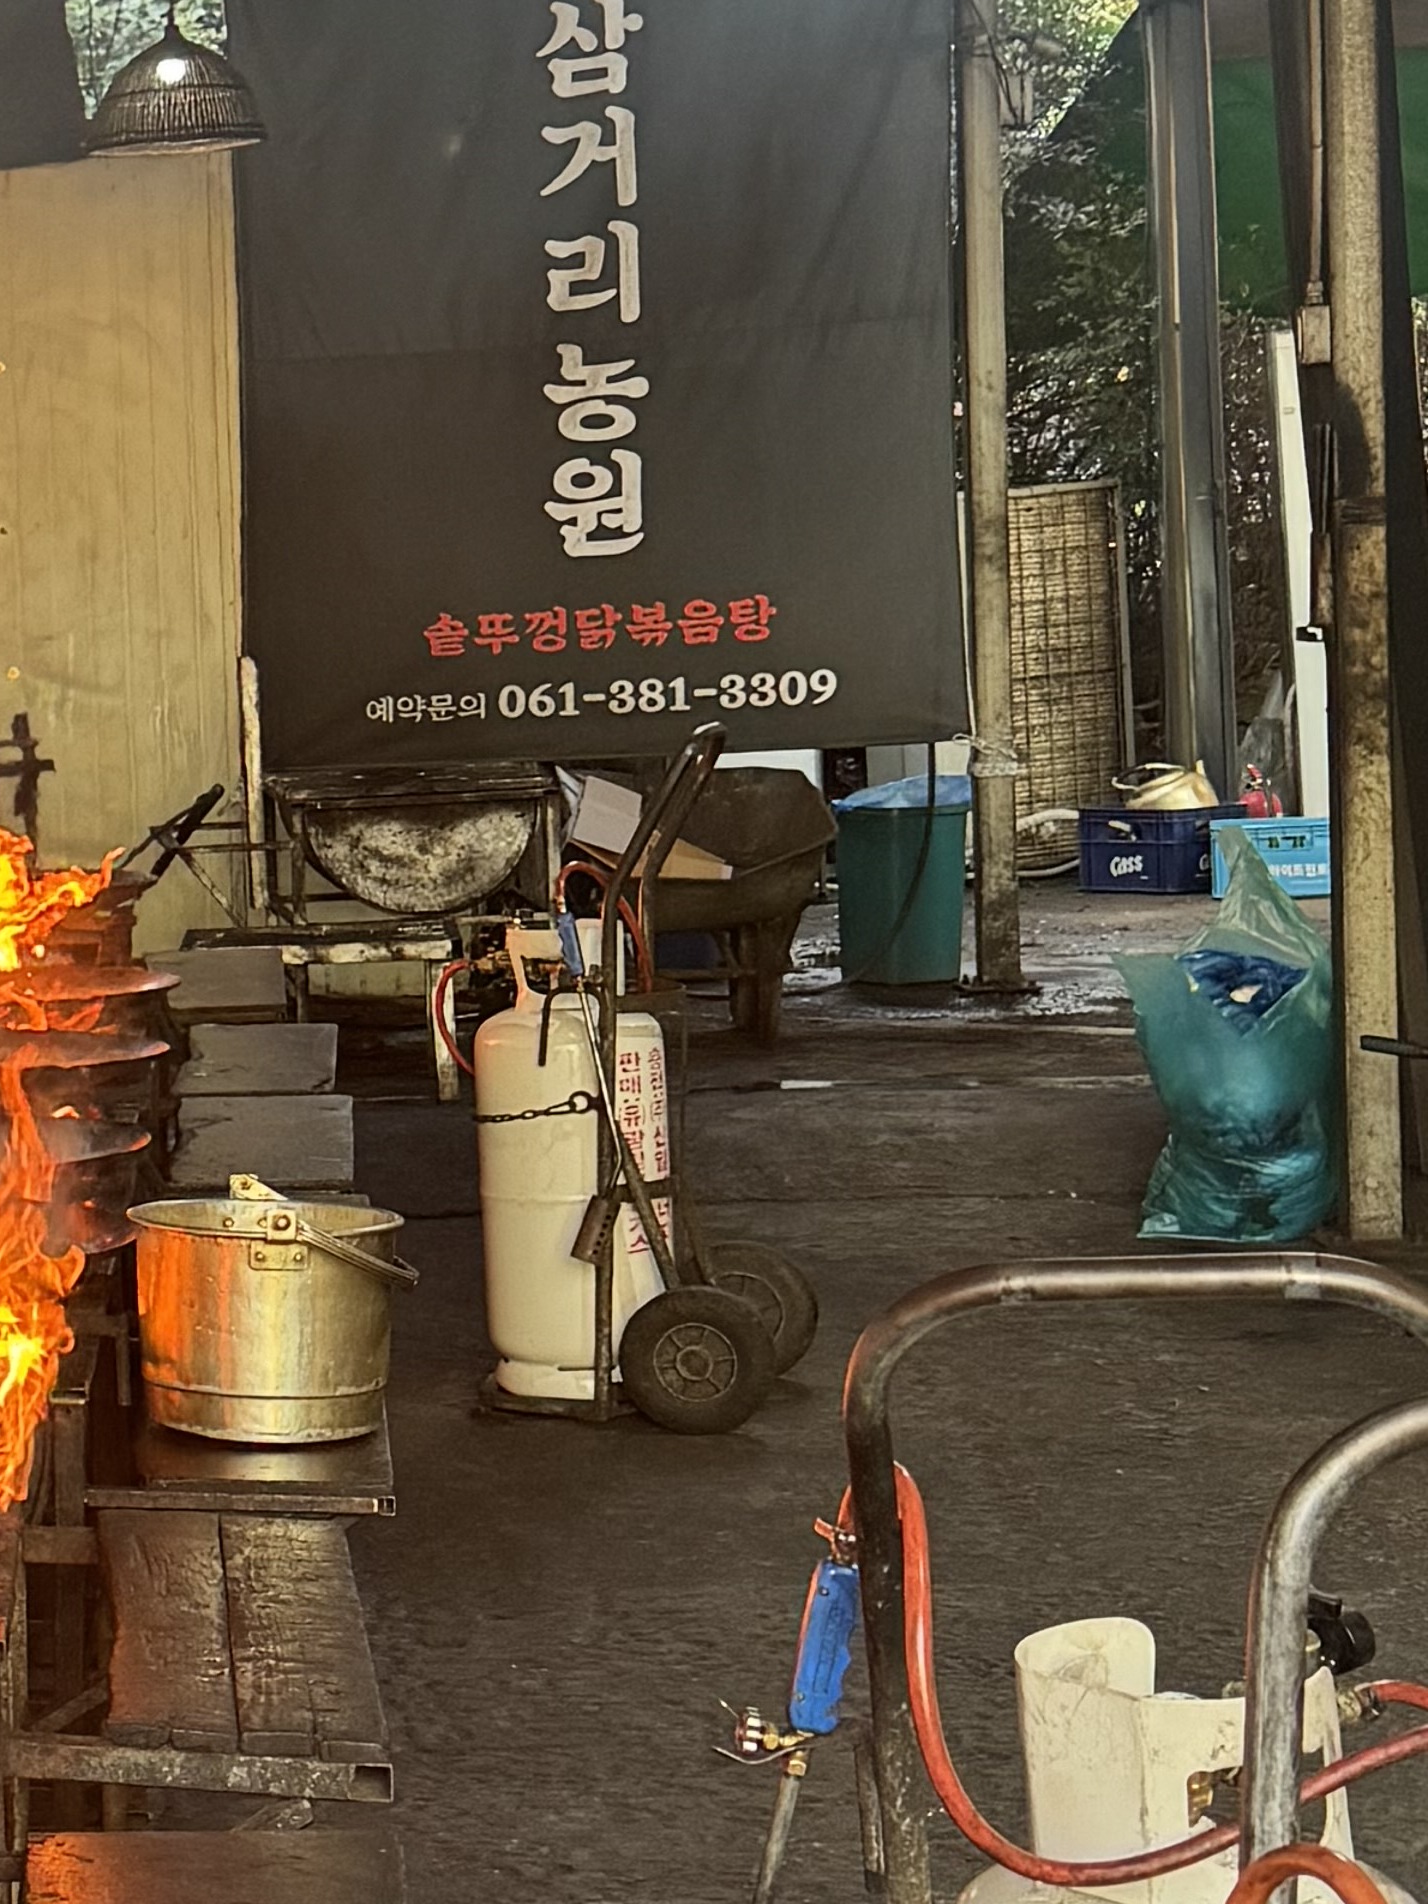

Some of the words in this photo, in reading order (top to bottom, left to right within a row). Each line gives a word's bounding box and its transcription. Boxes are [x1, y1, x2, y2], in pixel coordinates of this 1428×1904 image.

[423, 594, 778, 657] 솥뚜껑닭볶음탕
[365, 693, 487, 723] 예약문의
[497, 668, 838, 719] 061-381-3309
